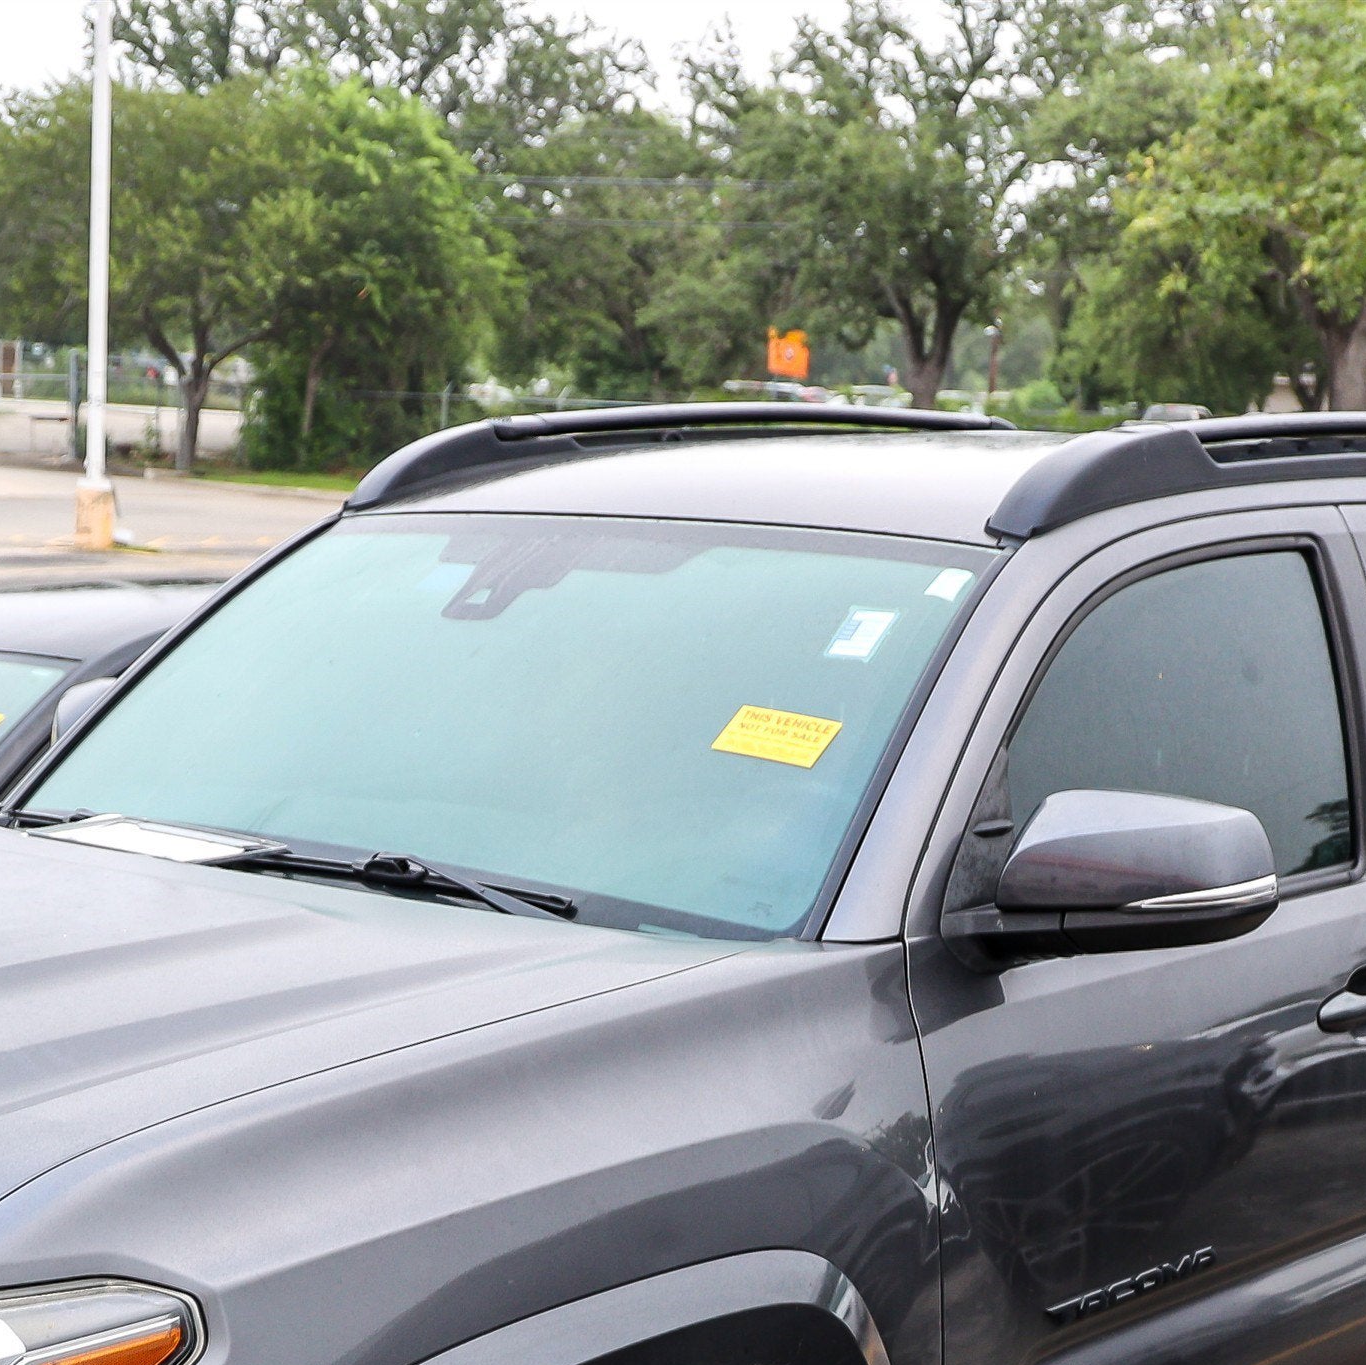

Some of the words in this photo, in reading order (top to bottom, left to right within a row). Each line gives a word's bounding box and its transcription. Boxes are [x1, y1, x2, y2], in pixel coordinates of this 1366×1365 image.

[739, 721, 761, 732] NOT
[763, 726, 788, 736] FOR
[792, 732, 821, 743] SALE
[743, 710, 771, 722] THIS
[775, 716, 834, 735] VEHICLE
[1045, 1245, 1216, 1323] TACOMA
